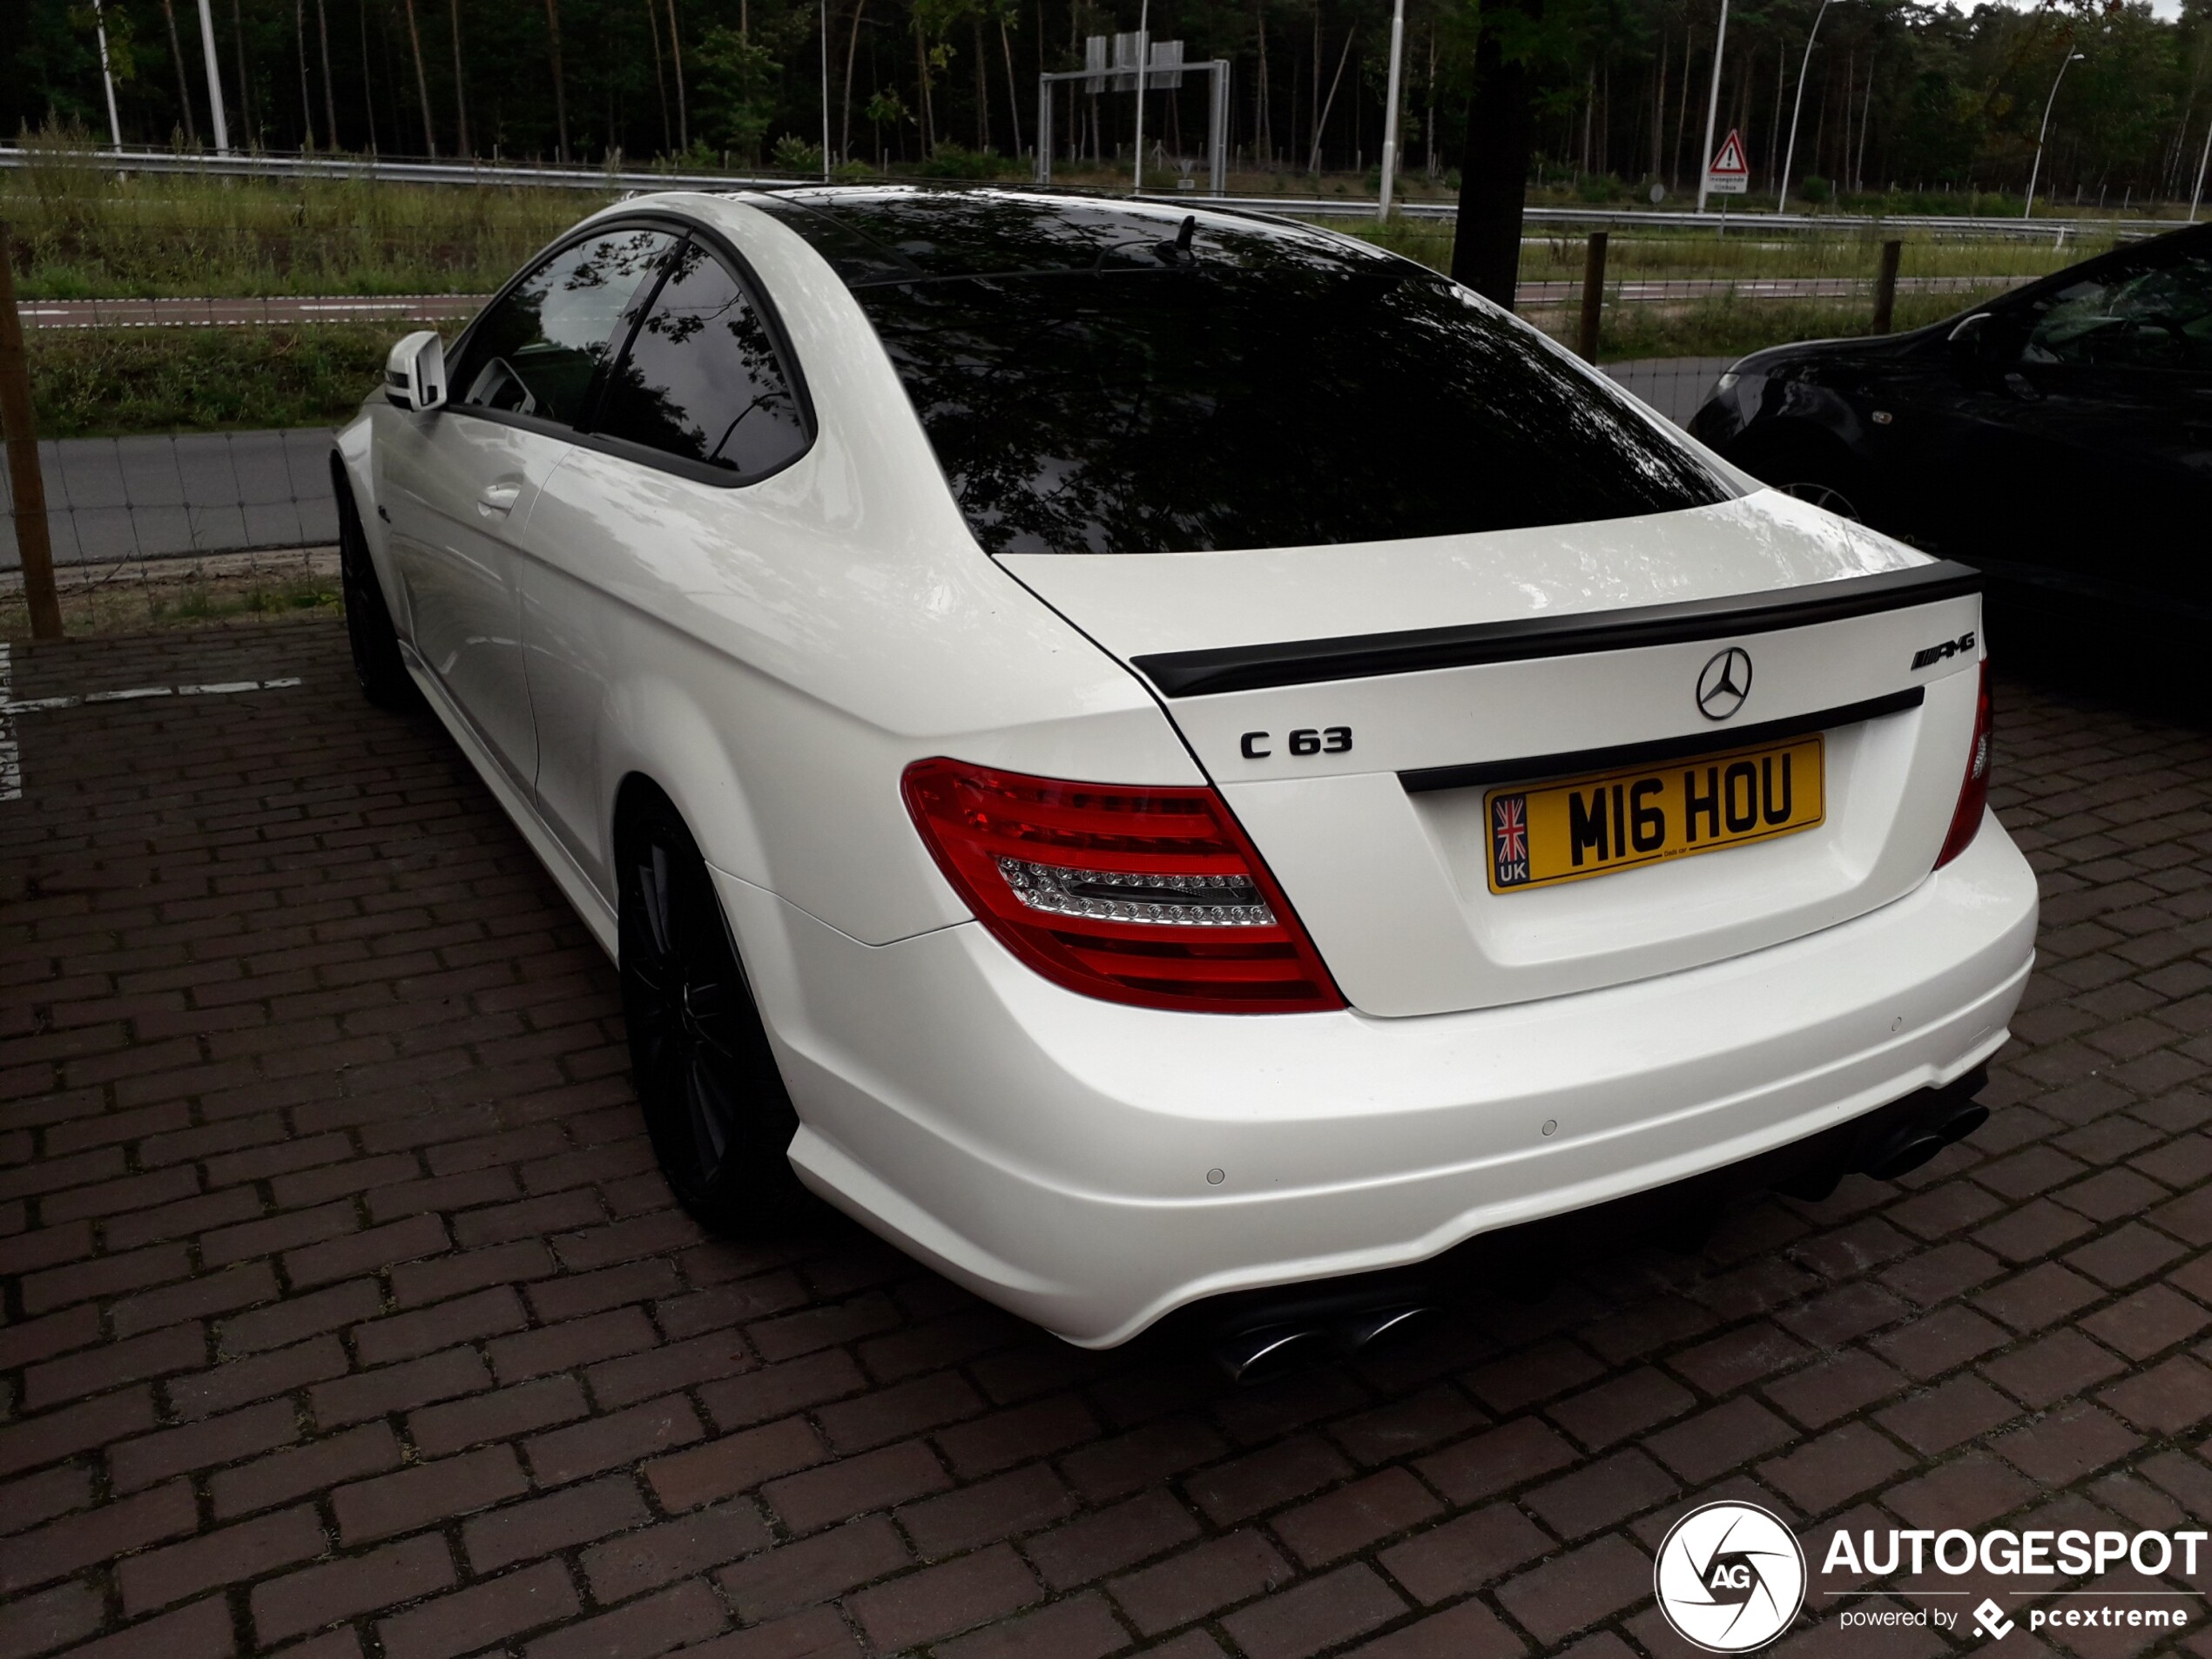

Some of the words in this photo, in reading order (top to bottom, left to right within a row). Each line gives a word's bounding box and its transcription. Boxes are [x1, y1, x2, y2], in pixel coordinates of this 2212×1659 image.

[1932, 631, 1975, 664] AMG
[1241, 732, 1271, 759] C
[1289, 726, 1352, 756] 63
[1569, 778, 1664, 867] M16
[1684, 752, 1792, 842] HOU
[1501, 862, 1527, 882] UK
